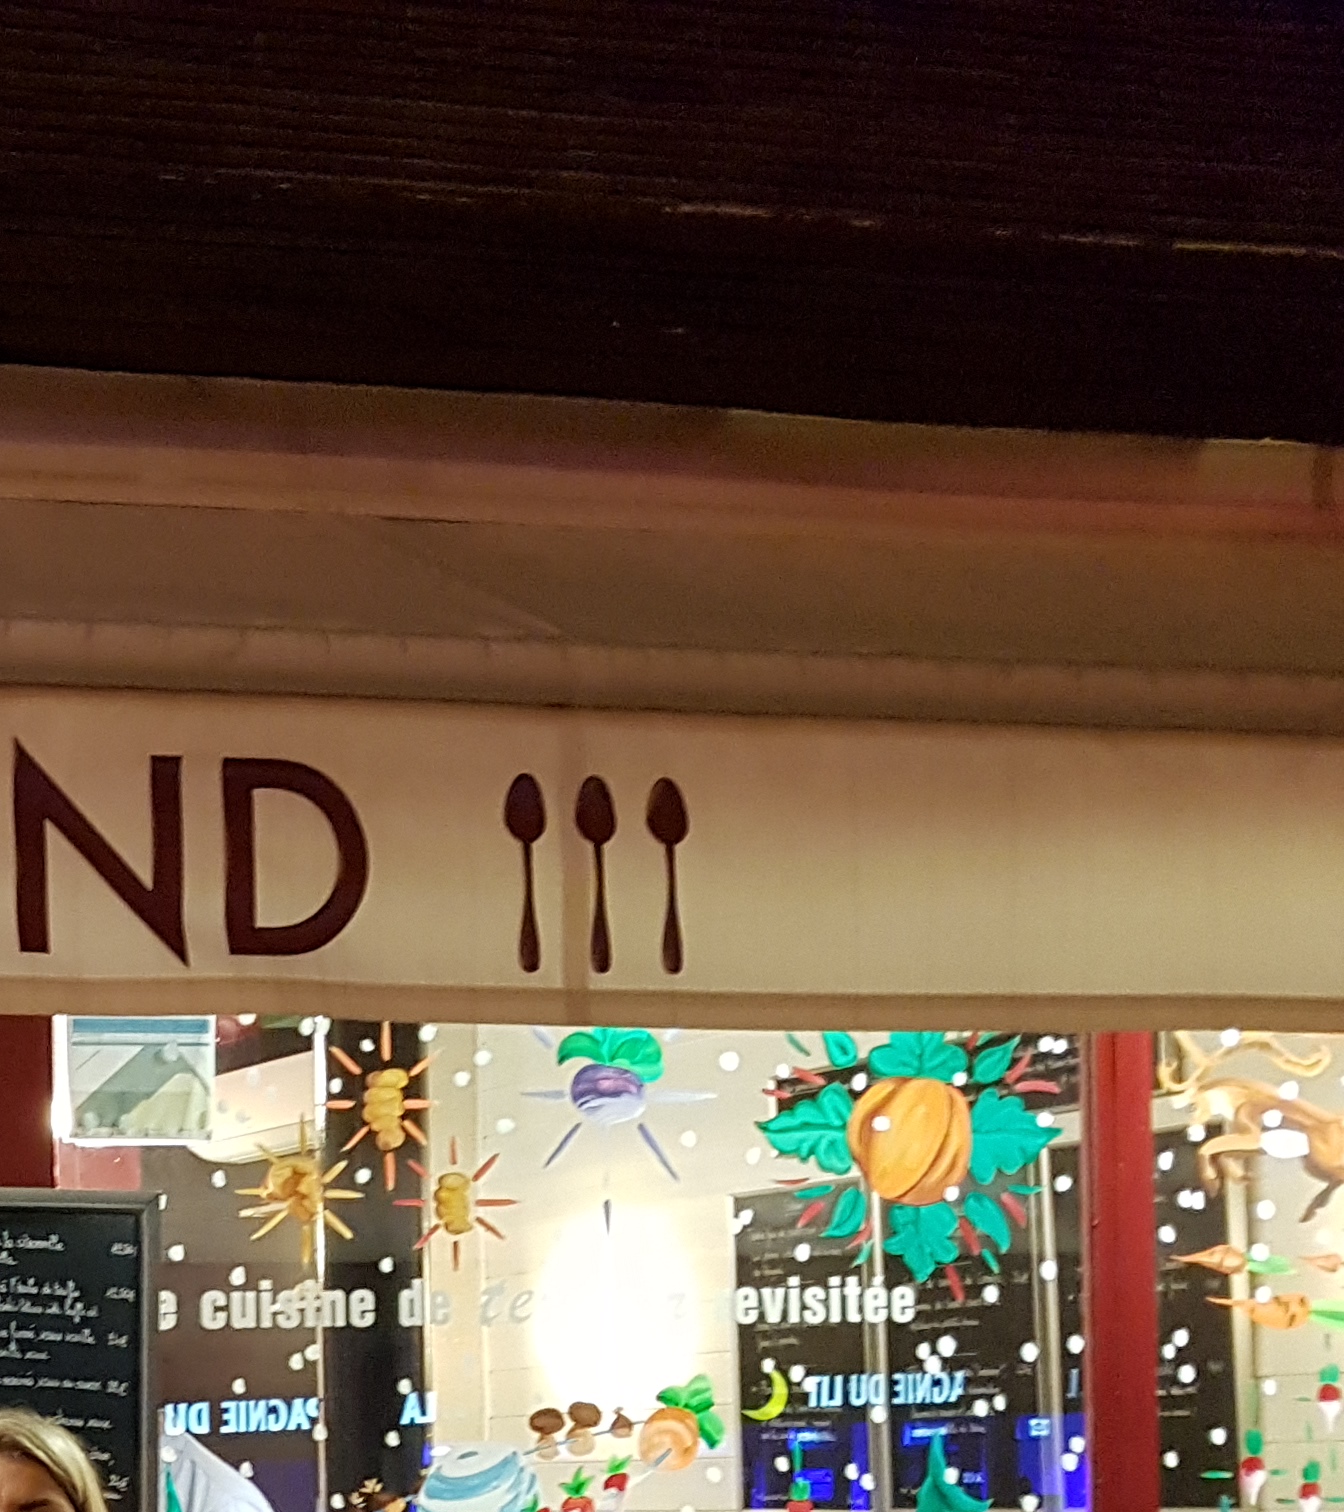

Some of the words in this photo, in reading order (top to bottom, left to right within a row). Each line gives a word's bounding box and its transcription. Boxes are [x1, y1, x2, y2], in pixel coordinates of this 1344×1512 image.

[199, 1279, 376, 1330] cuisine
[398, 1278, 451, 1328] de
[720, 1275, 917, 1325] evisitée
